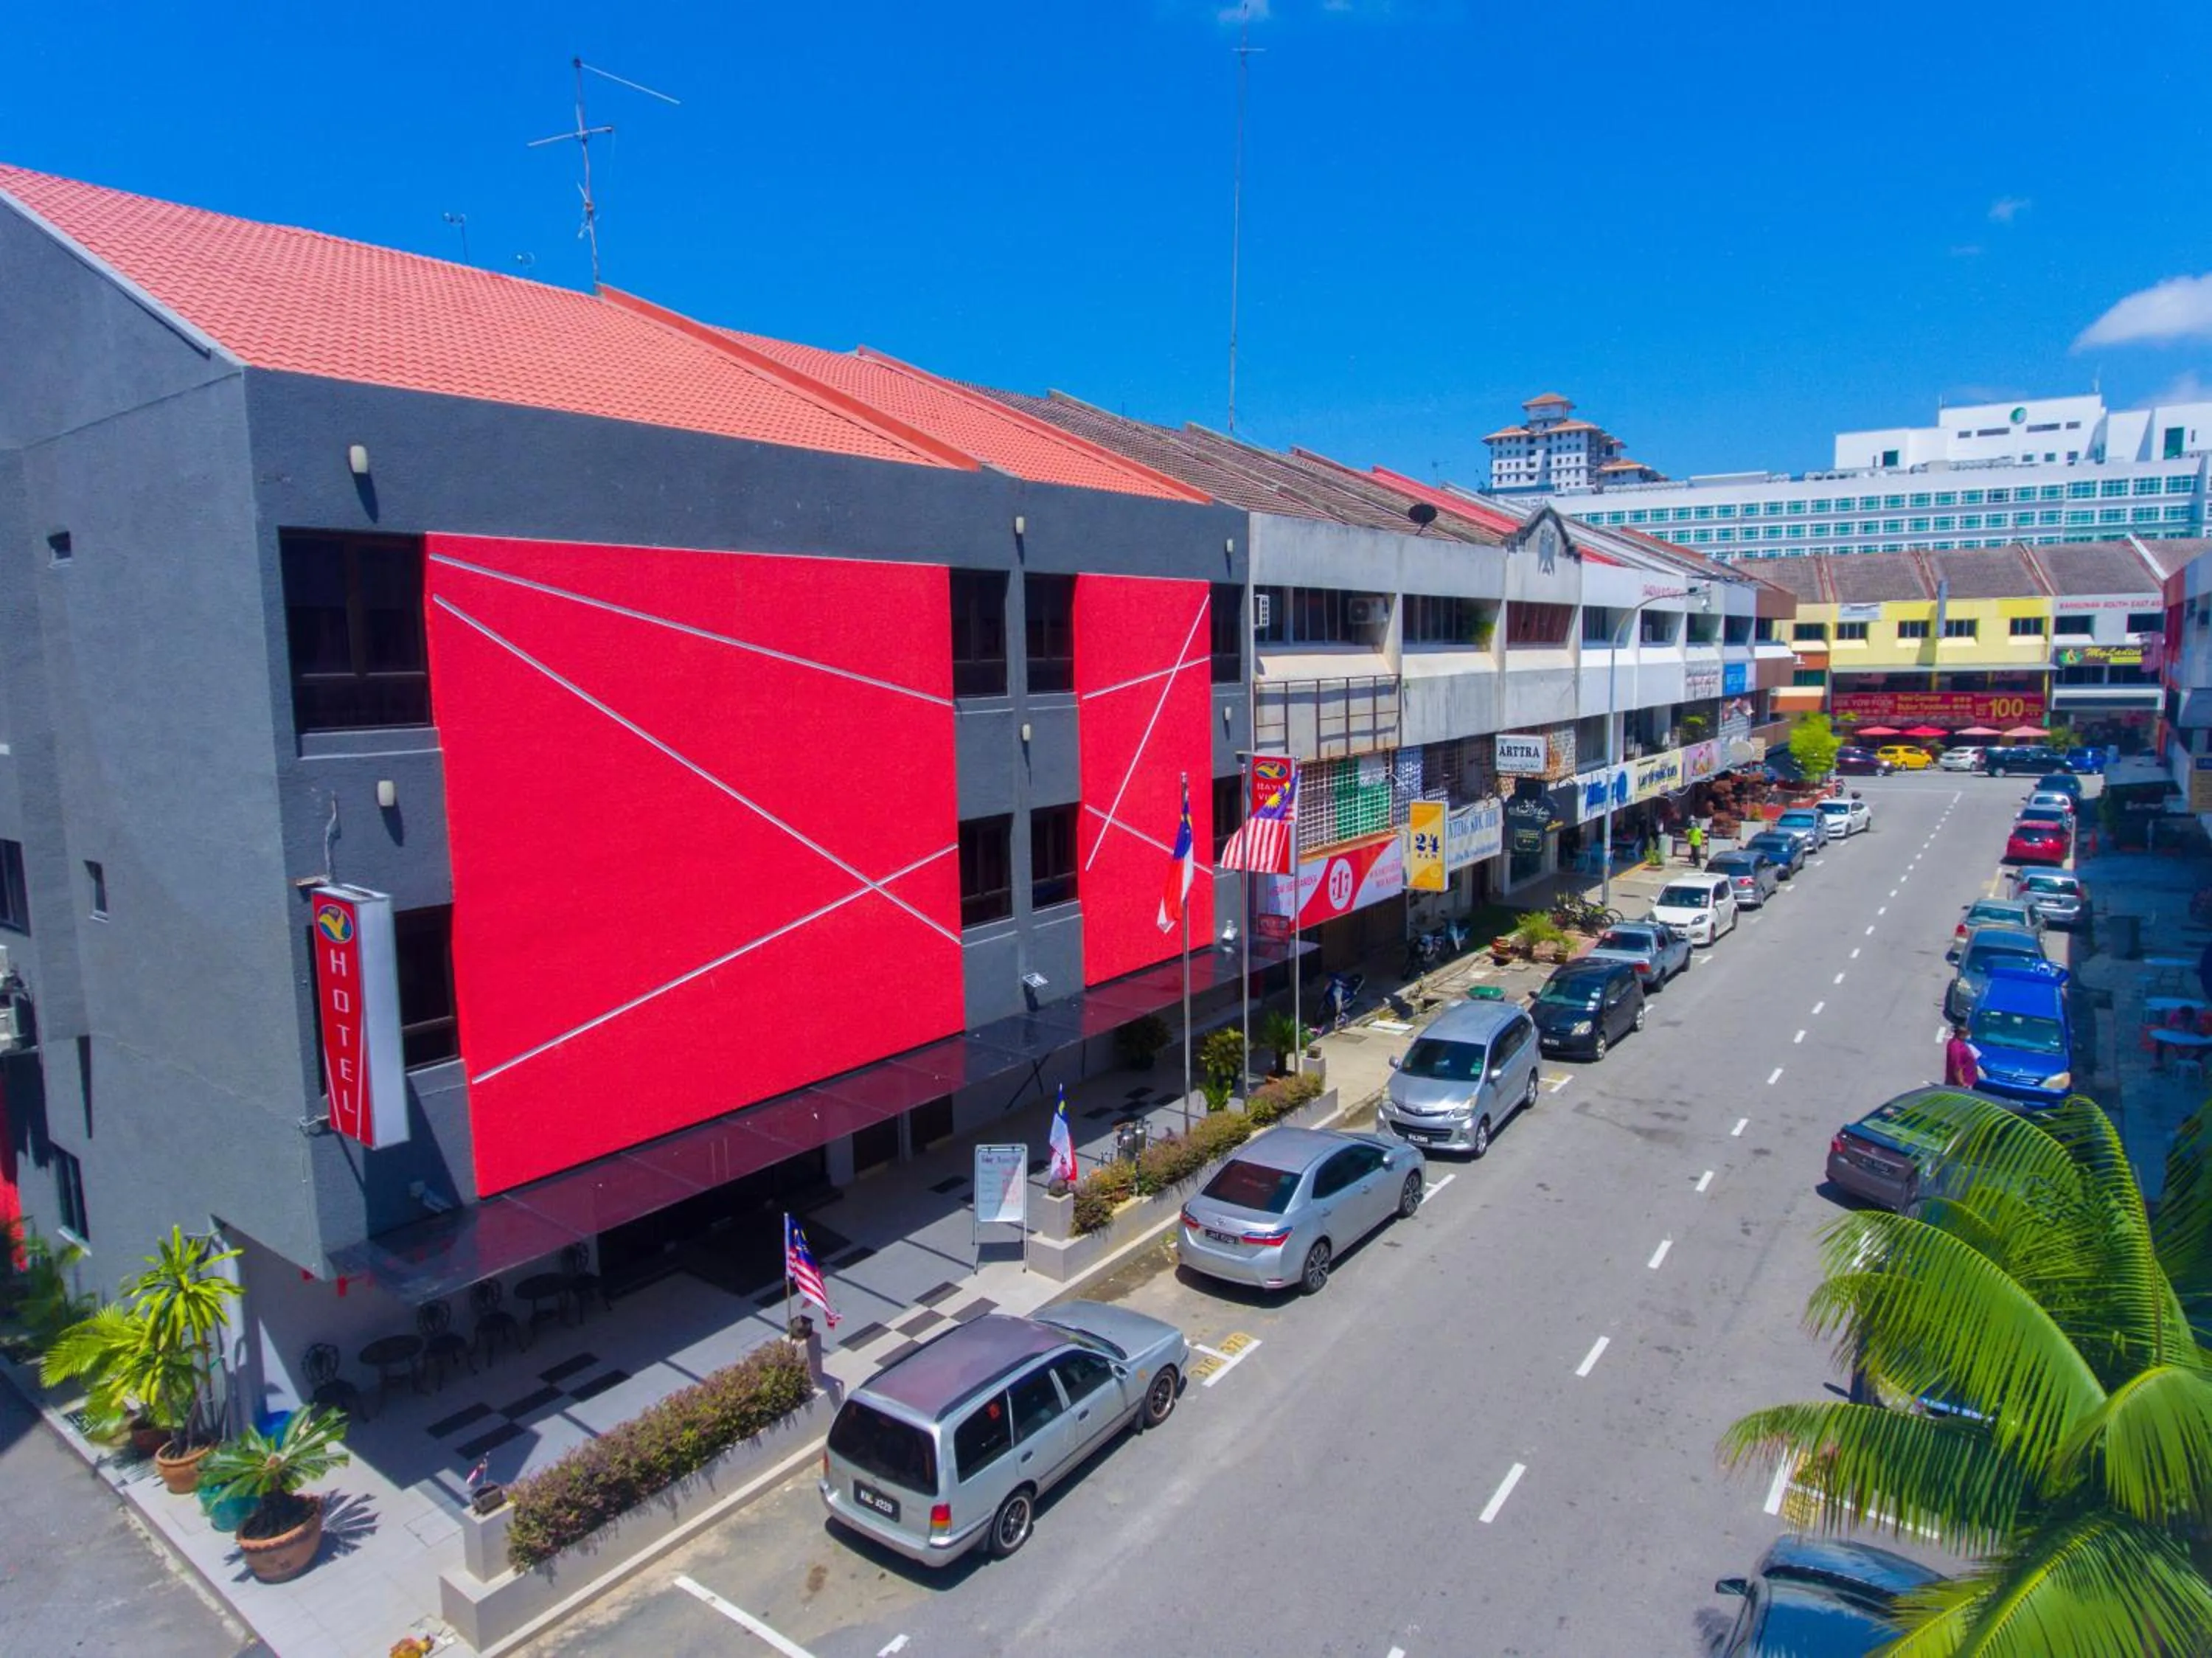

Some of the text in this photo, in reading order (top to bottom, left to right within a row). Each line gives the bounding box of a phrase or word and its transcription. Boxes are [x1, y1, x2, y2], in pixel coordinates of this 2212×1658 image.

[1989, 697, 2024, 718] 100
[1498, 745, 1540, 759] ARTTRA
[1416, 833, 1439, 853] 24
[330, 948, 356, 1115] HOTEL
